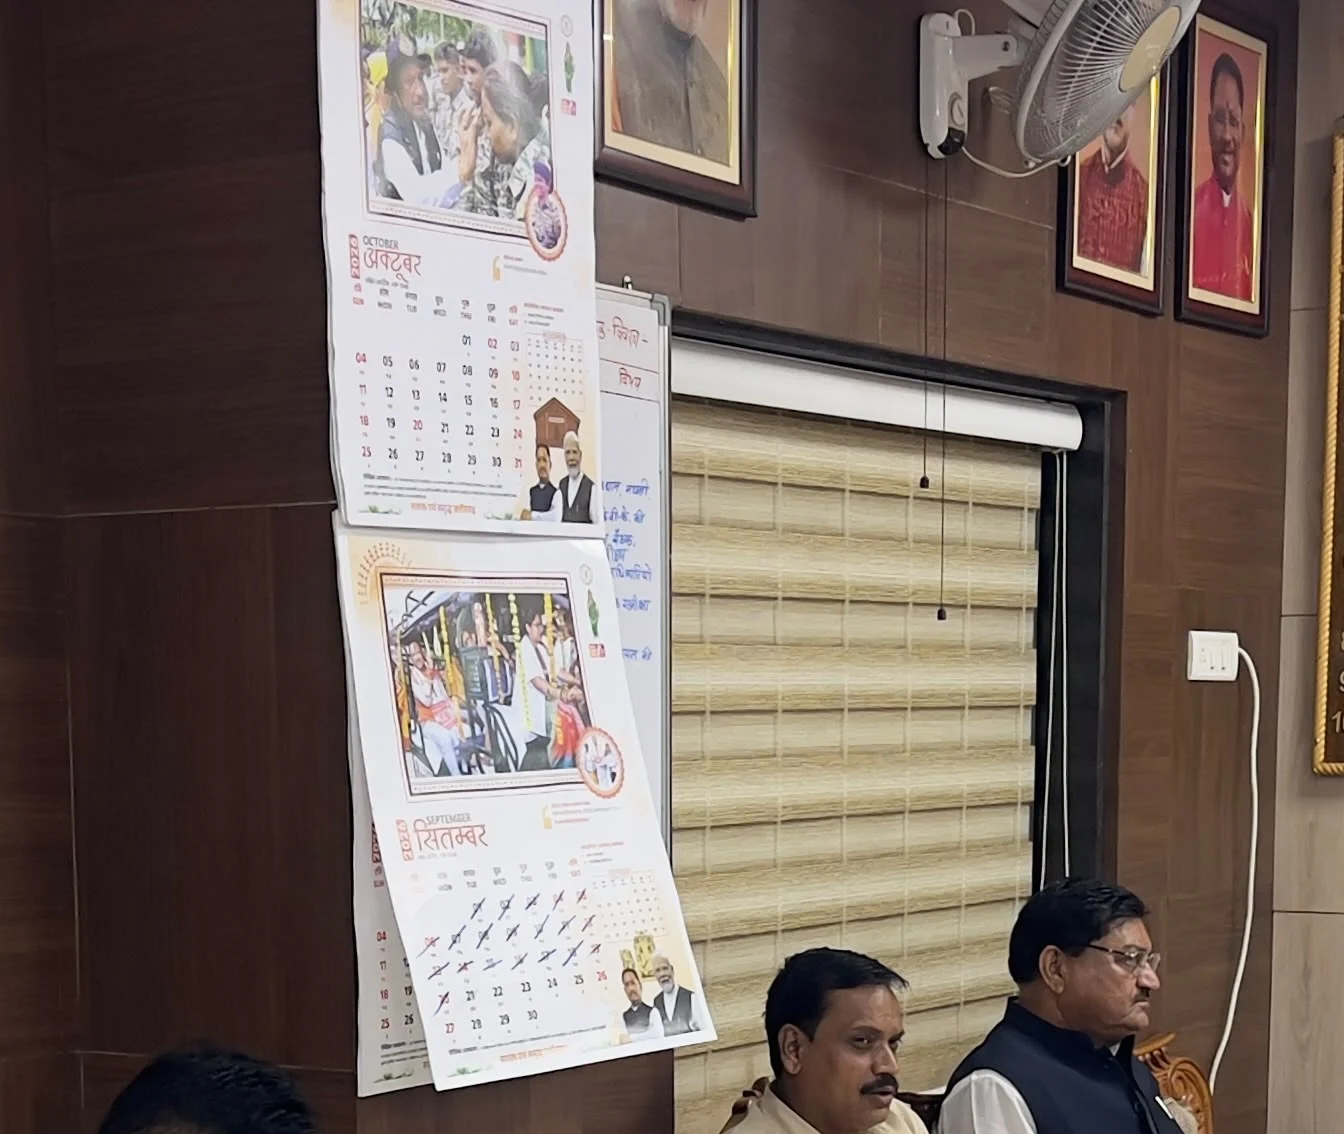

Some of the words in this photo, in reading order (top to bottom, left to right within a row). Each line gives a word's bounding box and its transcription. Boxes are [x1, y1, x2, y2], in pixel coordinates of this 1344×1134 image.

[363, 235, 399, 249] OCTOBER
[364, 248, 421, 283] अक्टूबर
[462, 335, 471, 346] 01
[488, 338, 497, 349] 02
[511, 341, 519, 352] 03
[356, 352, 366, 363] 04
[383, 356, 393, 367] 05
[409, 359, 419, 370] 06
[437, 362, 446, 373] 07
[463, 365, 472, 376] 08
[489, 368, 498, 379] 09
[512, 371, 520, 381] 10
[359, 384, 366, 395] 11
[385, 387, 393, 398] 12
[412, 390, 420, 400] 13
[439, 393, 447, 403] 14
[464, 395, 472, 406] 15
[490, 398, 498, 408] 16
[513, 400, 520, 409] 17
[360, 416, 369, 426] 18
[387, 418, 395, 428] 19
[413, 420, 423, 430] 20
[441, 422, 449, 433] 21
[465, 425, 474, 435] 22
[491, 427, 500, 438] 23
[513, 429, 522, 440] 24
[362, 447, 372, 458] 25
[388, 448, 398, 459] 26
[415, 451, 424, 461] 27
[442, 452, 451, 463] 28
[468, 455, 477, 465] 29
[492, 457, 501, 467] 30
[515, 458, 522, 468] 31
[413, 819, 488, 851] सितम्बर
